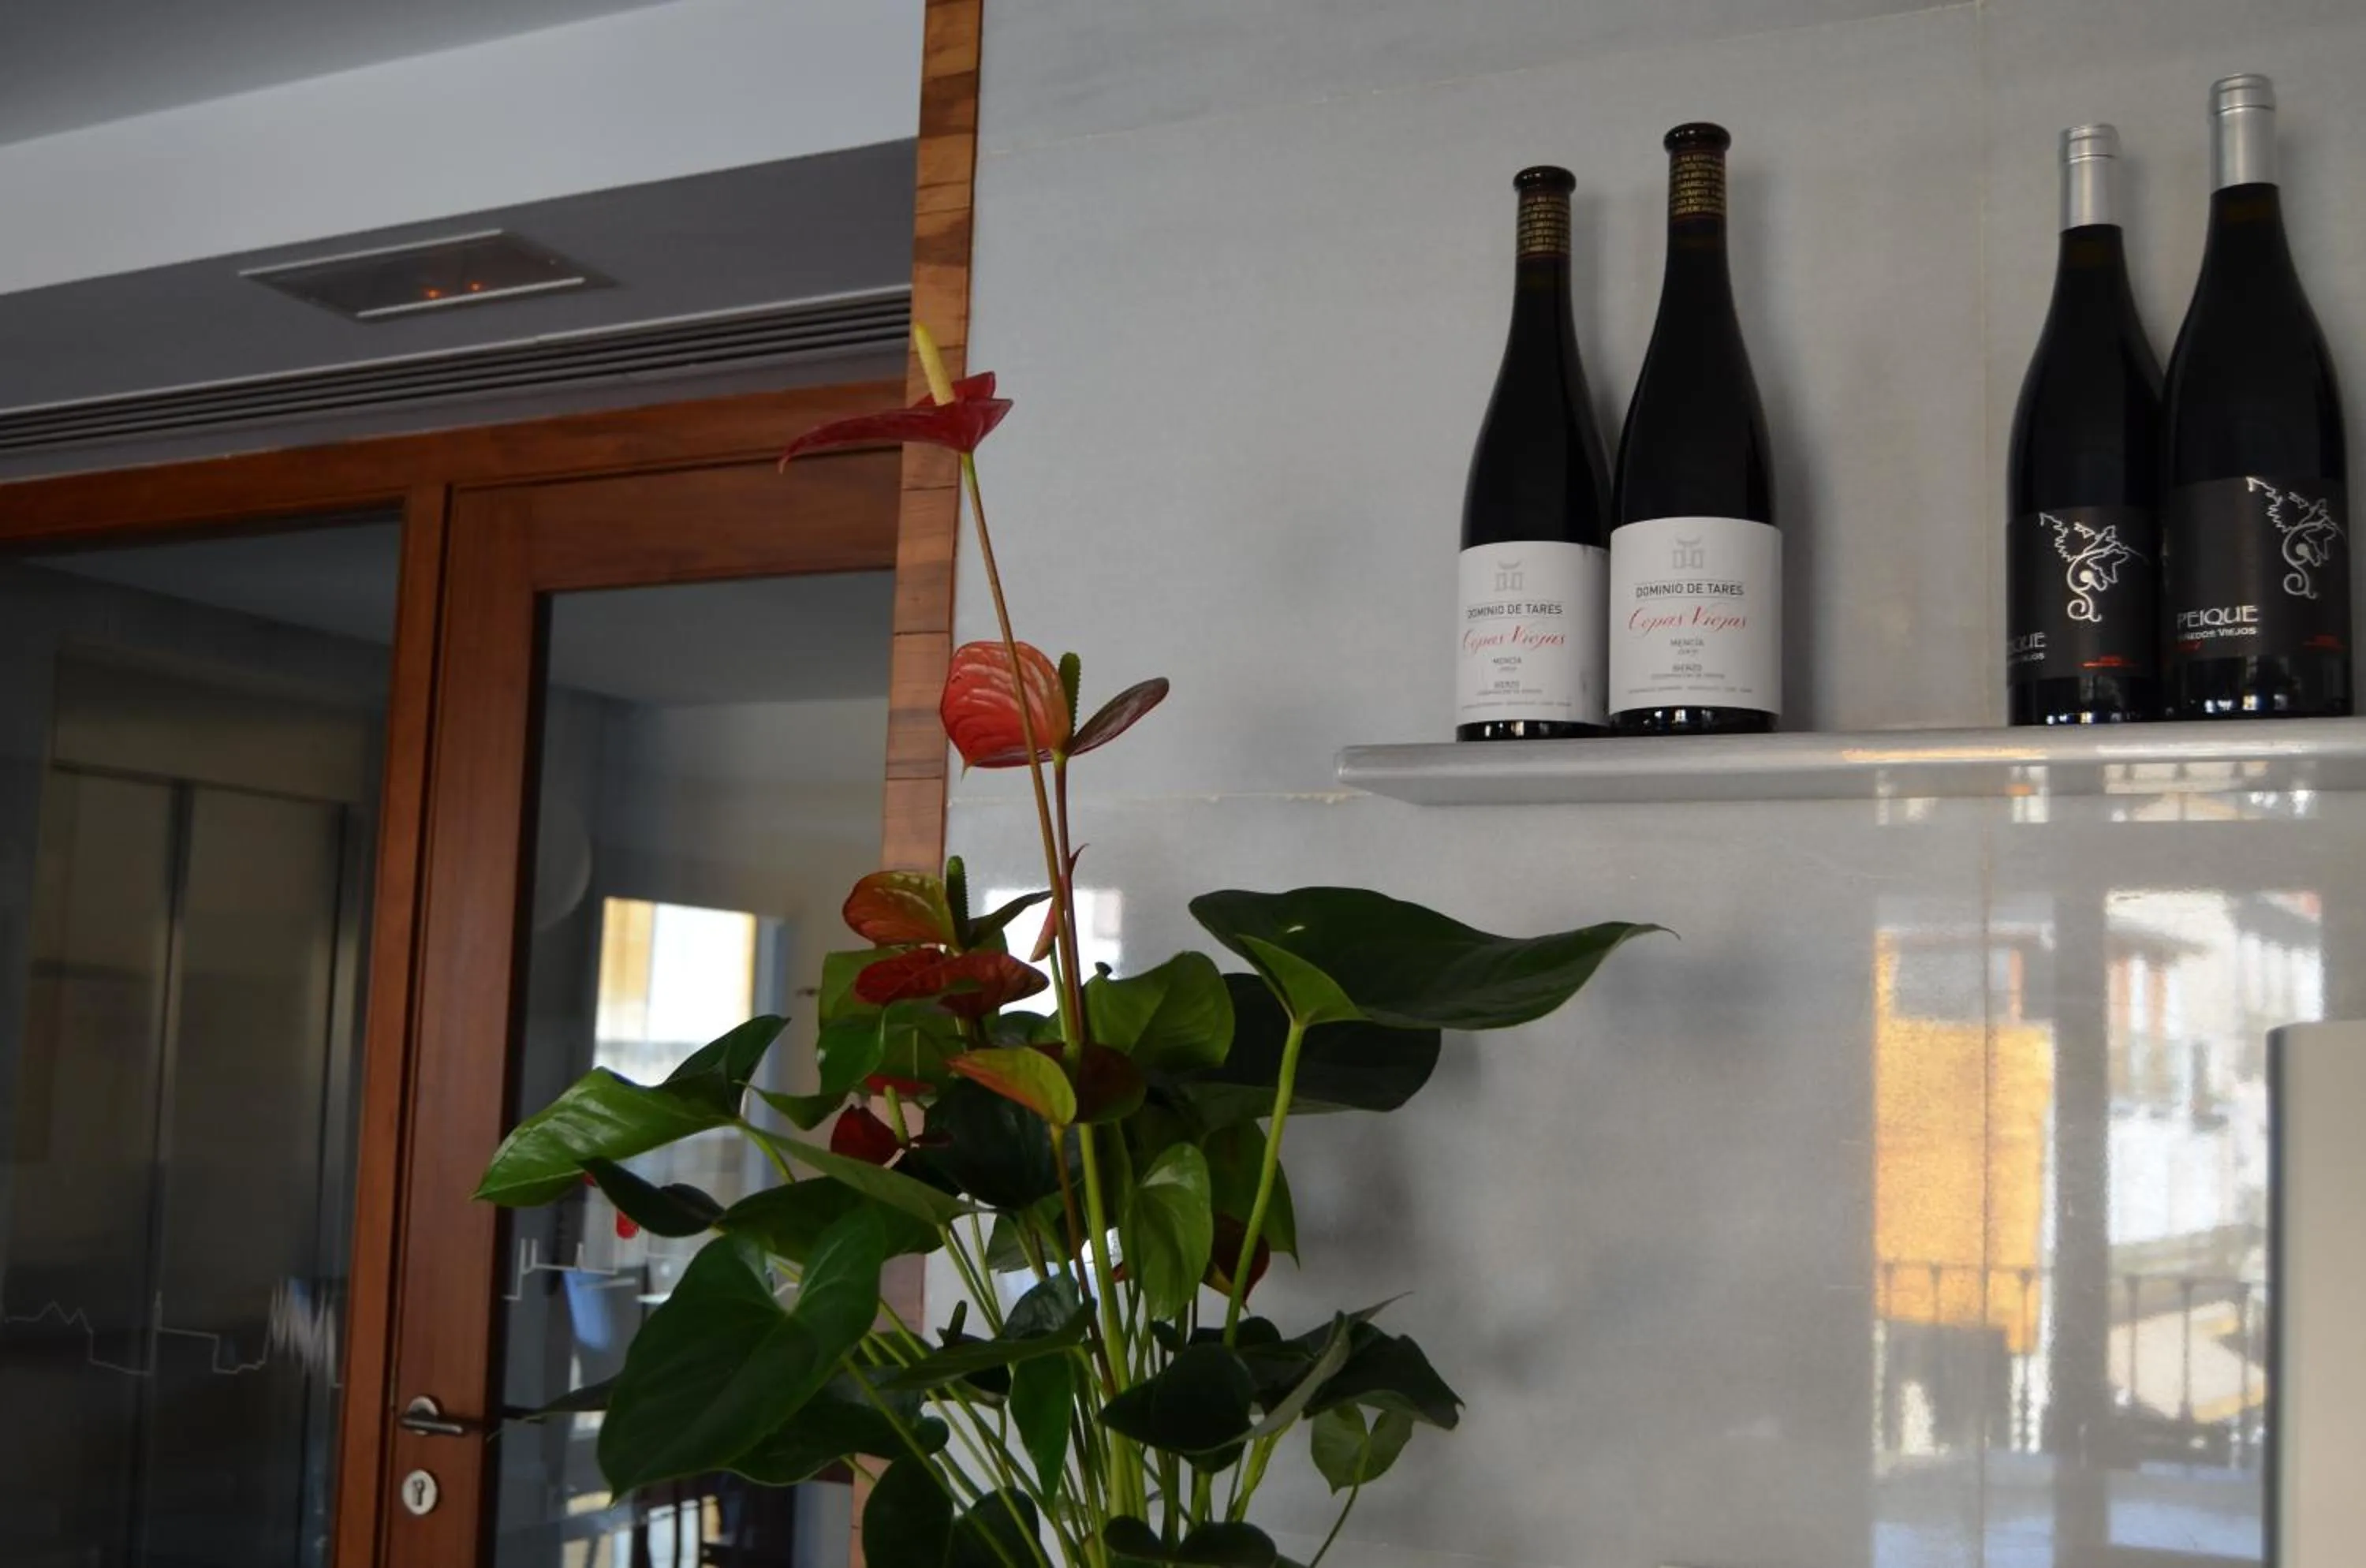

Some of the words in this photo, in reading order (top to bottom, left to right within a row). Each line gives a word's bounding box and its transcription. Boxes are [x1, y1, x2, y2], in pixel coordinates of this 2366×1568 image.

[1636, 583, 1683, 599] DOMINIO
[1687, 583, 1704, 594] DE
[1708, 583, 1745, 595] TARES
[1467, 604, 1504, 619] DOMINIO
[1507, 603, 1521, 615] DE
[1527, 603, 1563, 615] TARES
[2177, 605, 2259, 629] PEIQUE
